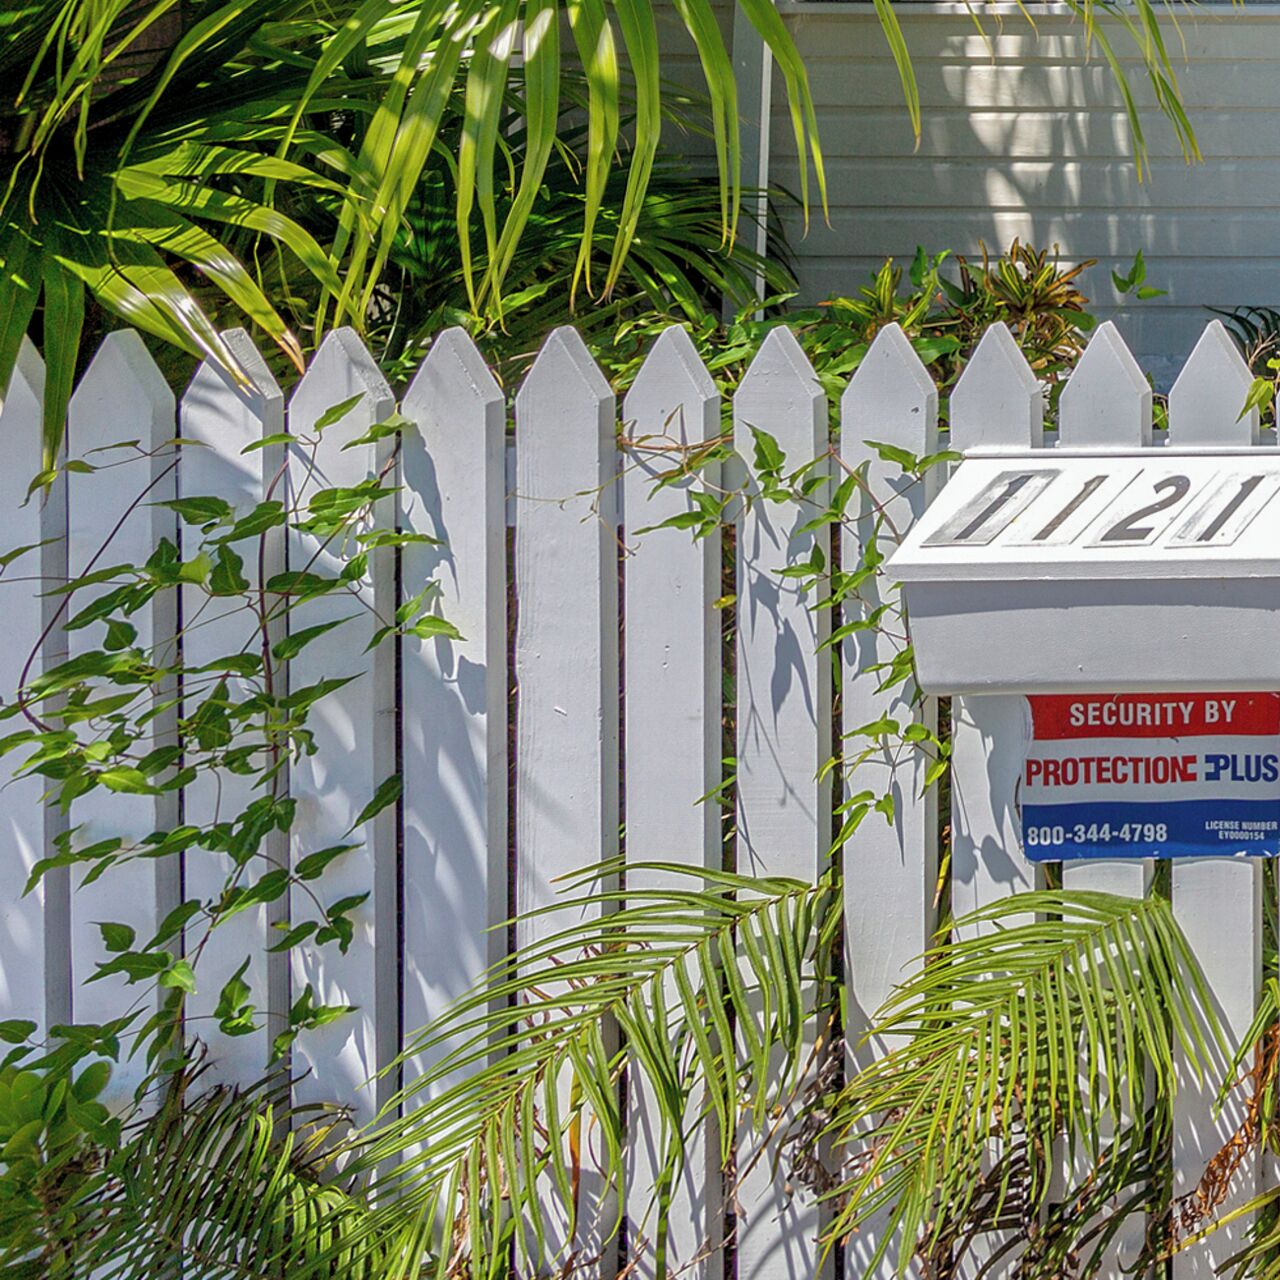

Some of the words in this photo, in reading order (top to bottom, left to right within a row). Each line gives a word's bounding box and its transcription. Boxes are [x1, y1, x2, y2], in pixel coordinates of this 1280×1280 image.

[953, 474, 1266, 543] 1121
[1069, 701, 1195, 727] SECURITY
[1204, 699, 1237, 724] BY
[1025, 754, 1198, 787] PROTECTION
[1204, 753, 1279, 783] PLUS
[1027, 823, 1168, 846] 800-344-4798
[1204, 820, 1240, 831] LICENSE
[1241, 820, 1279, 831] NUMBER
